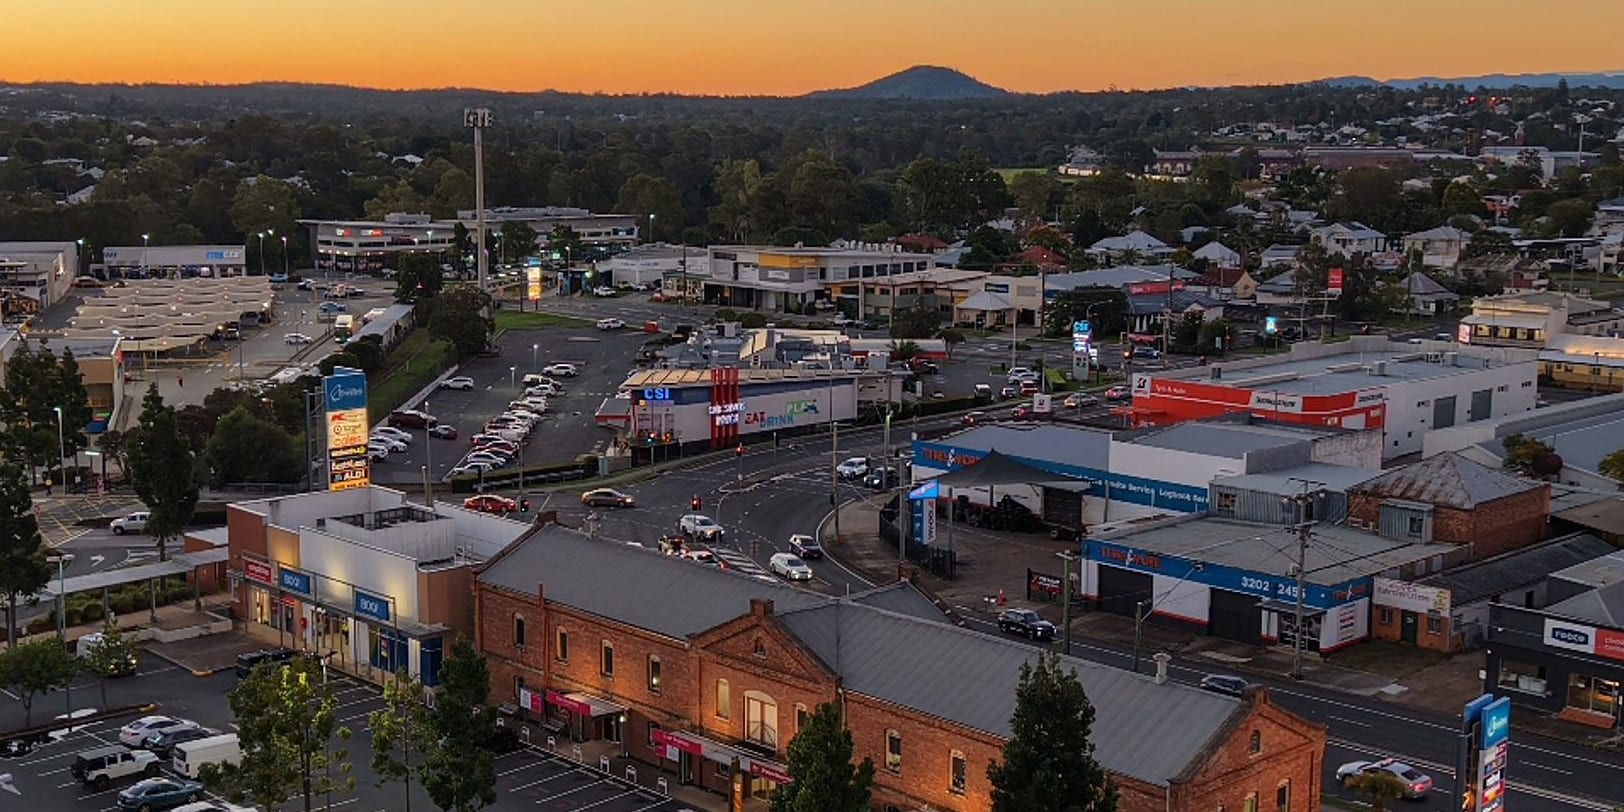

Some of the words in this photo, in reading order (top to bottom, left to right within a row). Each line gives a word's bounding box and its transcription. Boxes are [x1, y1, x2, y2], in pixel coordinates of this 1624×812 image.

[644, 388, 669, 400] CSI
[745, 411, 765, 425] EAT
[1240, 576, 1270, 592] 3202
[1555, 630, 1586, 643] repco
